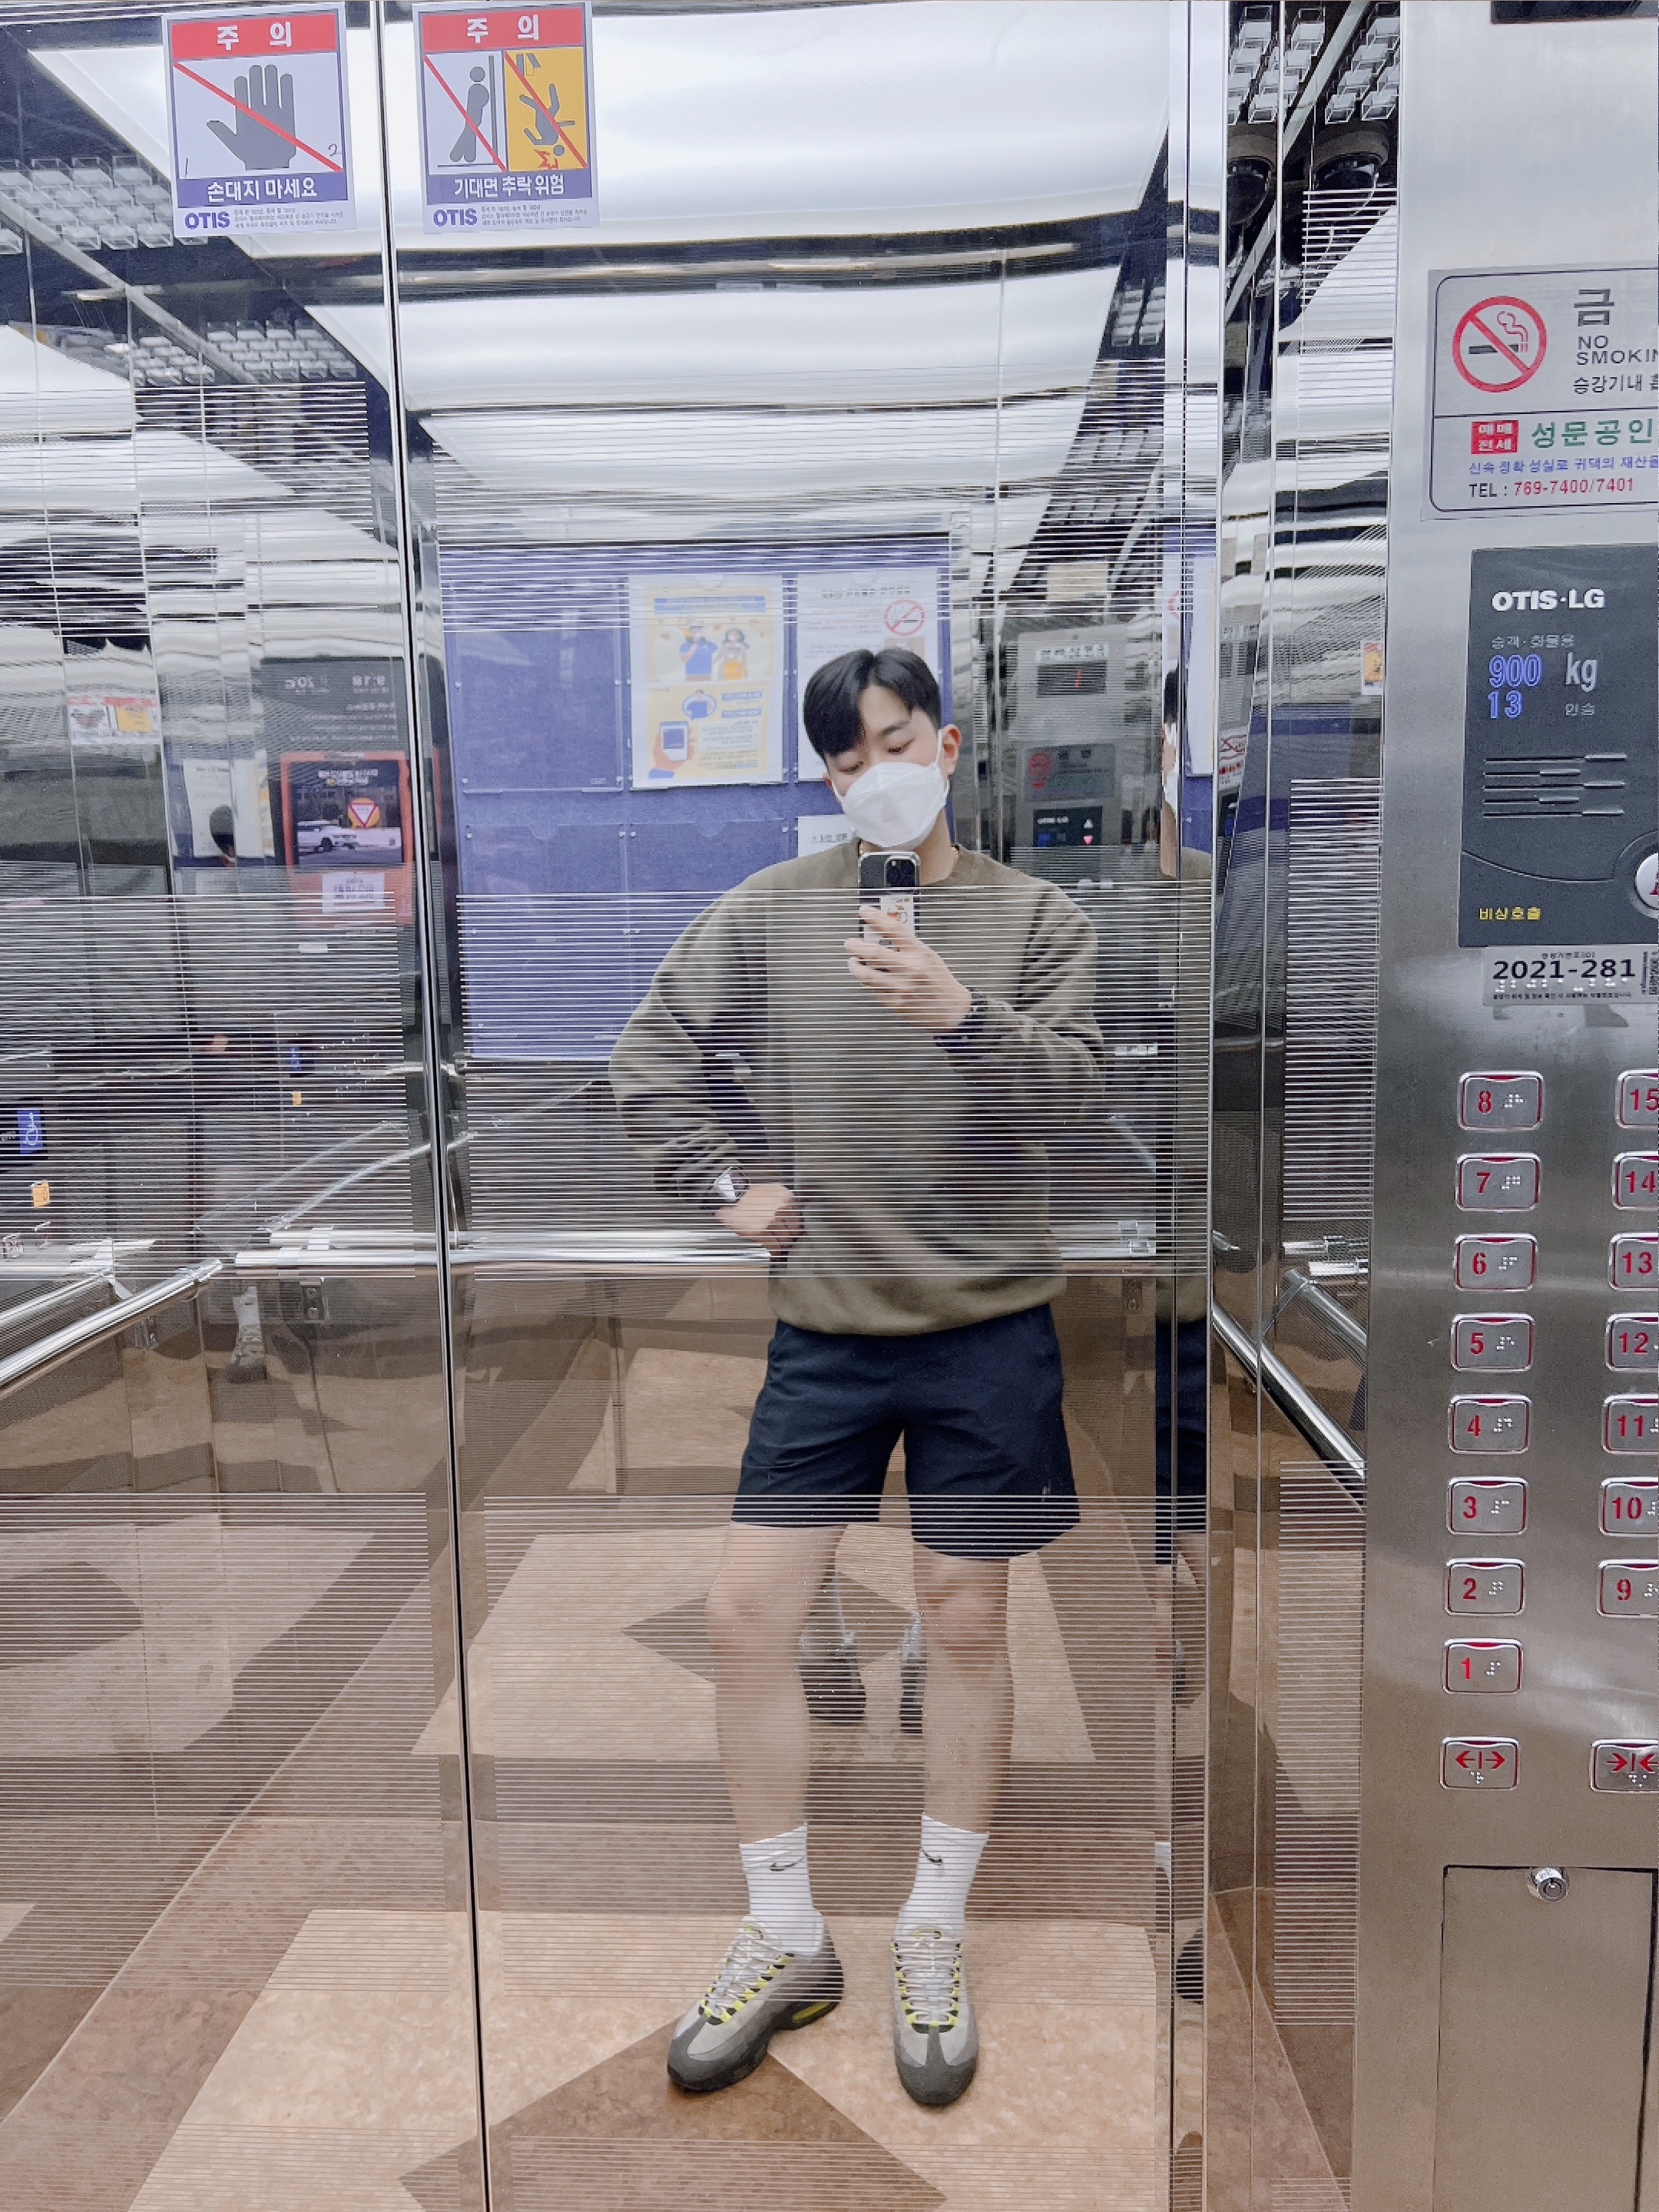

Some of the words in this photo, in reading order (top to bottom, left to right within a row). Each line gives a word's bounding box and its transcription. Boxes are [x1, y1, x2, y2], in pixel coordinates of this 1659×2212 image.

[207, 181, 260, 203] 손대지
[264, 177, 318, 200] 마세요
[454, 177, 498, 199] 기대면
[502, 175, 532, 197] 추락
[535, 174, 565, 196] 위험
[184, 211, 230, 230] OTIS
[432, 208, 478, 227] OTIS
[1574, 288, 1614, 326] 금
[1578, 335, 1608, 349] NO
[1573, 373, 1643, 395] 승강기내
[1532, 419, 1653, 449] 성문공인
[1469, 482, 1498, 498] TEL
[1513, 477, 1634, 496] 769-7400/7401
[1488, 654, 1543, 688] 900
[1565, 651, 1598, 693] kg
[1488, 690, 1523, 719] 13
[1479, 906, 1542, 920] 비상호출
[1492, 959, 1636, 980] 2021-281
[1476, 1091, 1492, 1113] 8
[1630, 1088, 1658, 1111] 15
[1477, 1171, 1491, 1193] 7
[1624, 1171, 1656, 1194] 14
[1472, 1253, 1487, 1275] 6
[1621, 1252, 1653, 1274] 13
[1470, 1332, 1485, 1355] 5
[1618, 1333, 1649, 1354] 12
[1467, 1415, 1482, 1437] 4
[1618, 1415, 1644, 1437] 11
[1463, 1495, 1478, 1519] 3
[1611, 1498, 1642, 1519] 10
[1462, 1578, 1477, 1600] 2
[1617, 1579, 1632, 1601] 9
[1461, 1657, 1472, 1681] 1
